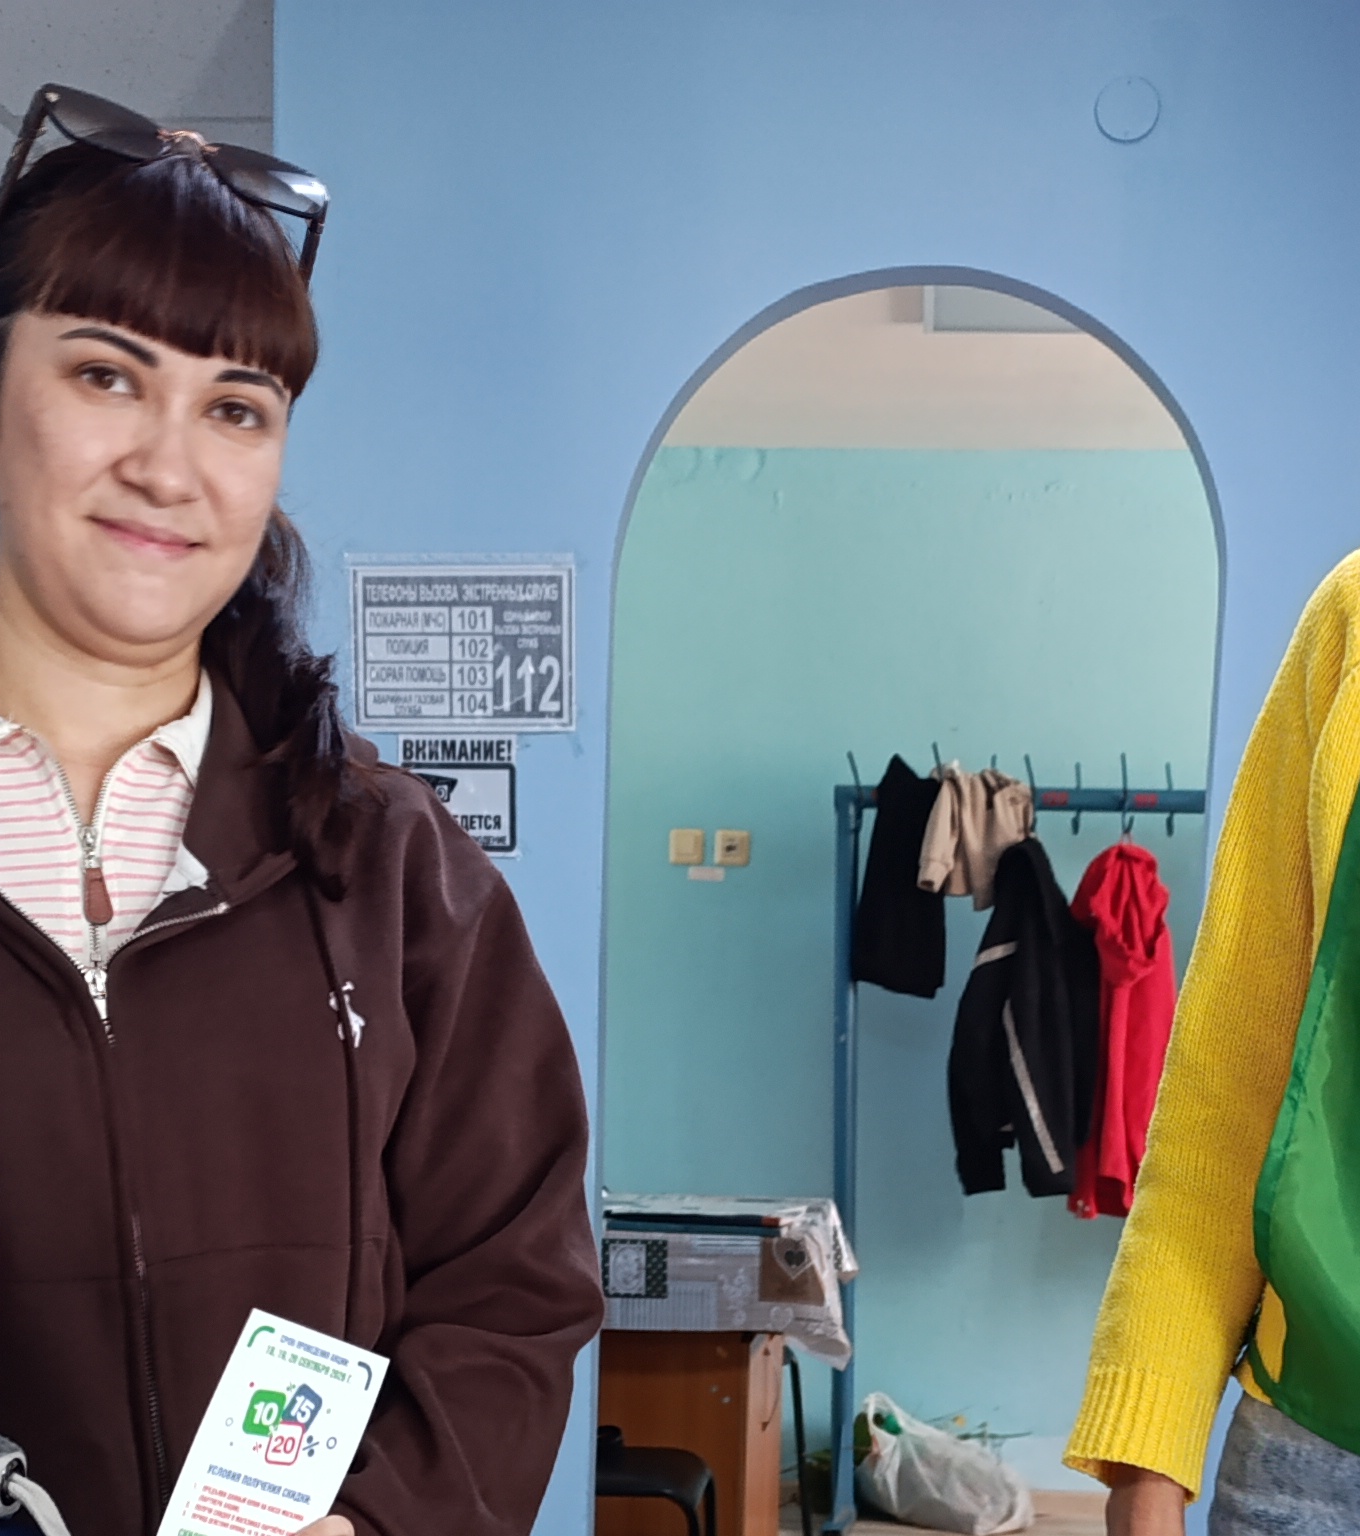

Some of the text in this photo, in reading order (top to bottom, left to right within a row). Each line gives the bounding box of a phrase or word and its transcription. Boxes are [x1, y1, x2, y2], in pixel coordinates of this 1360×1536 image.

[365, 584, 417, 601] ТЕЛЕФОНЫ
[420, 584, 458, 601] ВЫЗОВА
[463, 584, 523, 601] ЭКСТРЕННЫХ
[369, 611, 418, 625] ПОЖАРНАЯ
[458, 611, 487, 630] 101
[386, 638, 488, 658] ПОЛИЦИЯ 102
[370, 666, 488, 685] СКОРАЯ ПОМОЩЬ 103
[495, 655, 561, 712] 112
[458, 695, 488, 713] 104
[402, 739, 513, 761] ВНИМАНИЕ!
[453, 815, 502, 832] ДЕТСЯ
[253, 1401, 279, 1426] 10
[290, 1395, 314, 1423] 15
[272, 1435, 296, 1454] 20
[206, 1464, 241, 1482] УСЛОВИЯ
